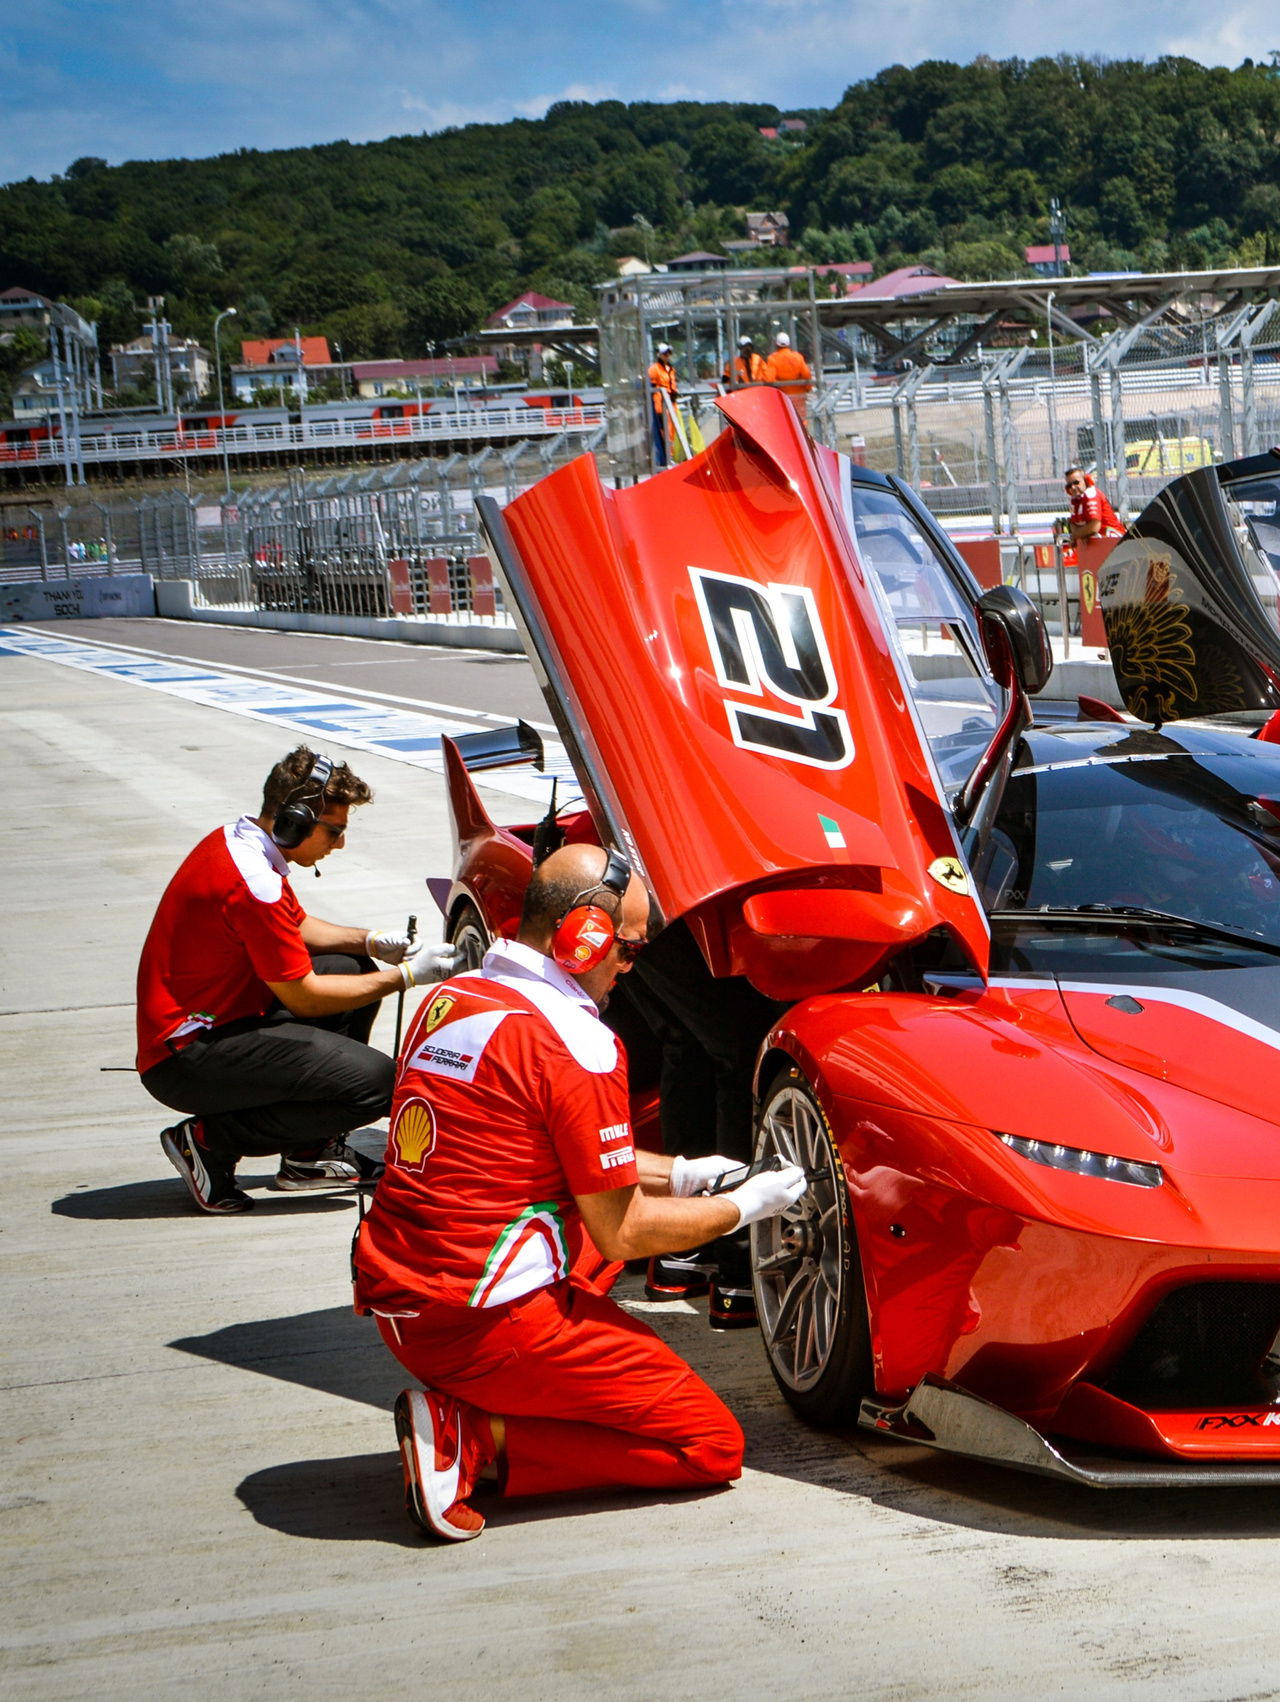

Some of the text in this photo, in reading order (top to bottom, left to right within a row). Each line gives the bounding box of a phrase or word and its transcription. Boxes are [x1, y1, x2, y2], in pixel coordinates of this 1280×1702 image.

[687, 565, 855, 771] 21
[422, 1044, 461, 1060] SCUDERIA
[431, 1055, 469, 1071] FERRARI
